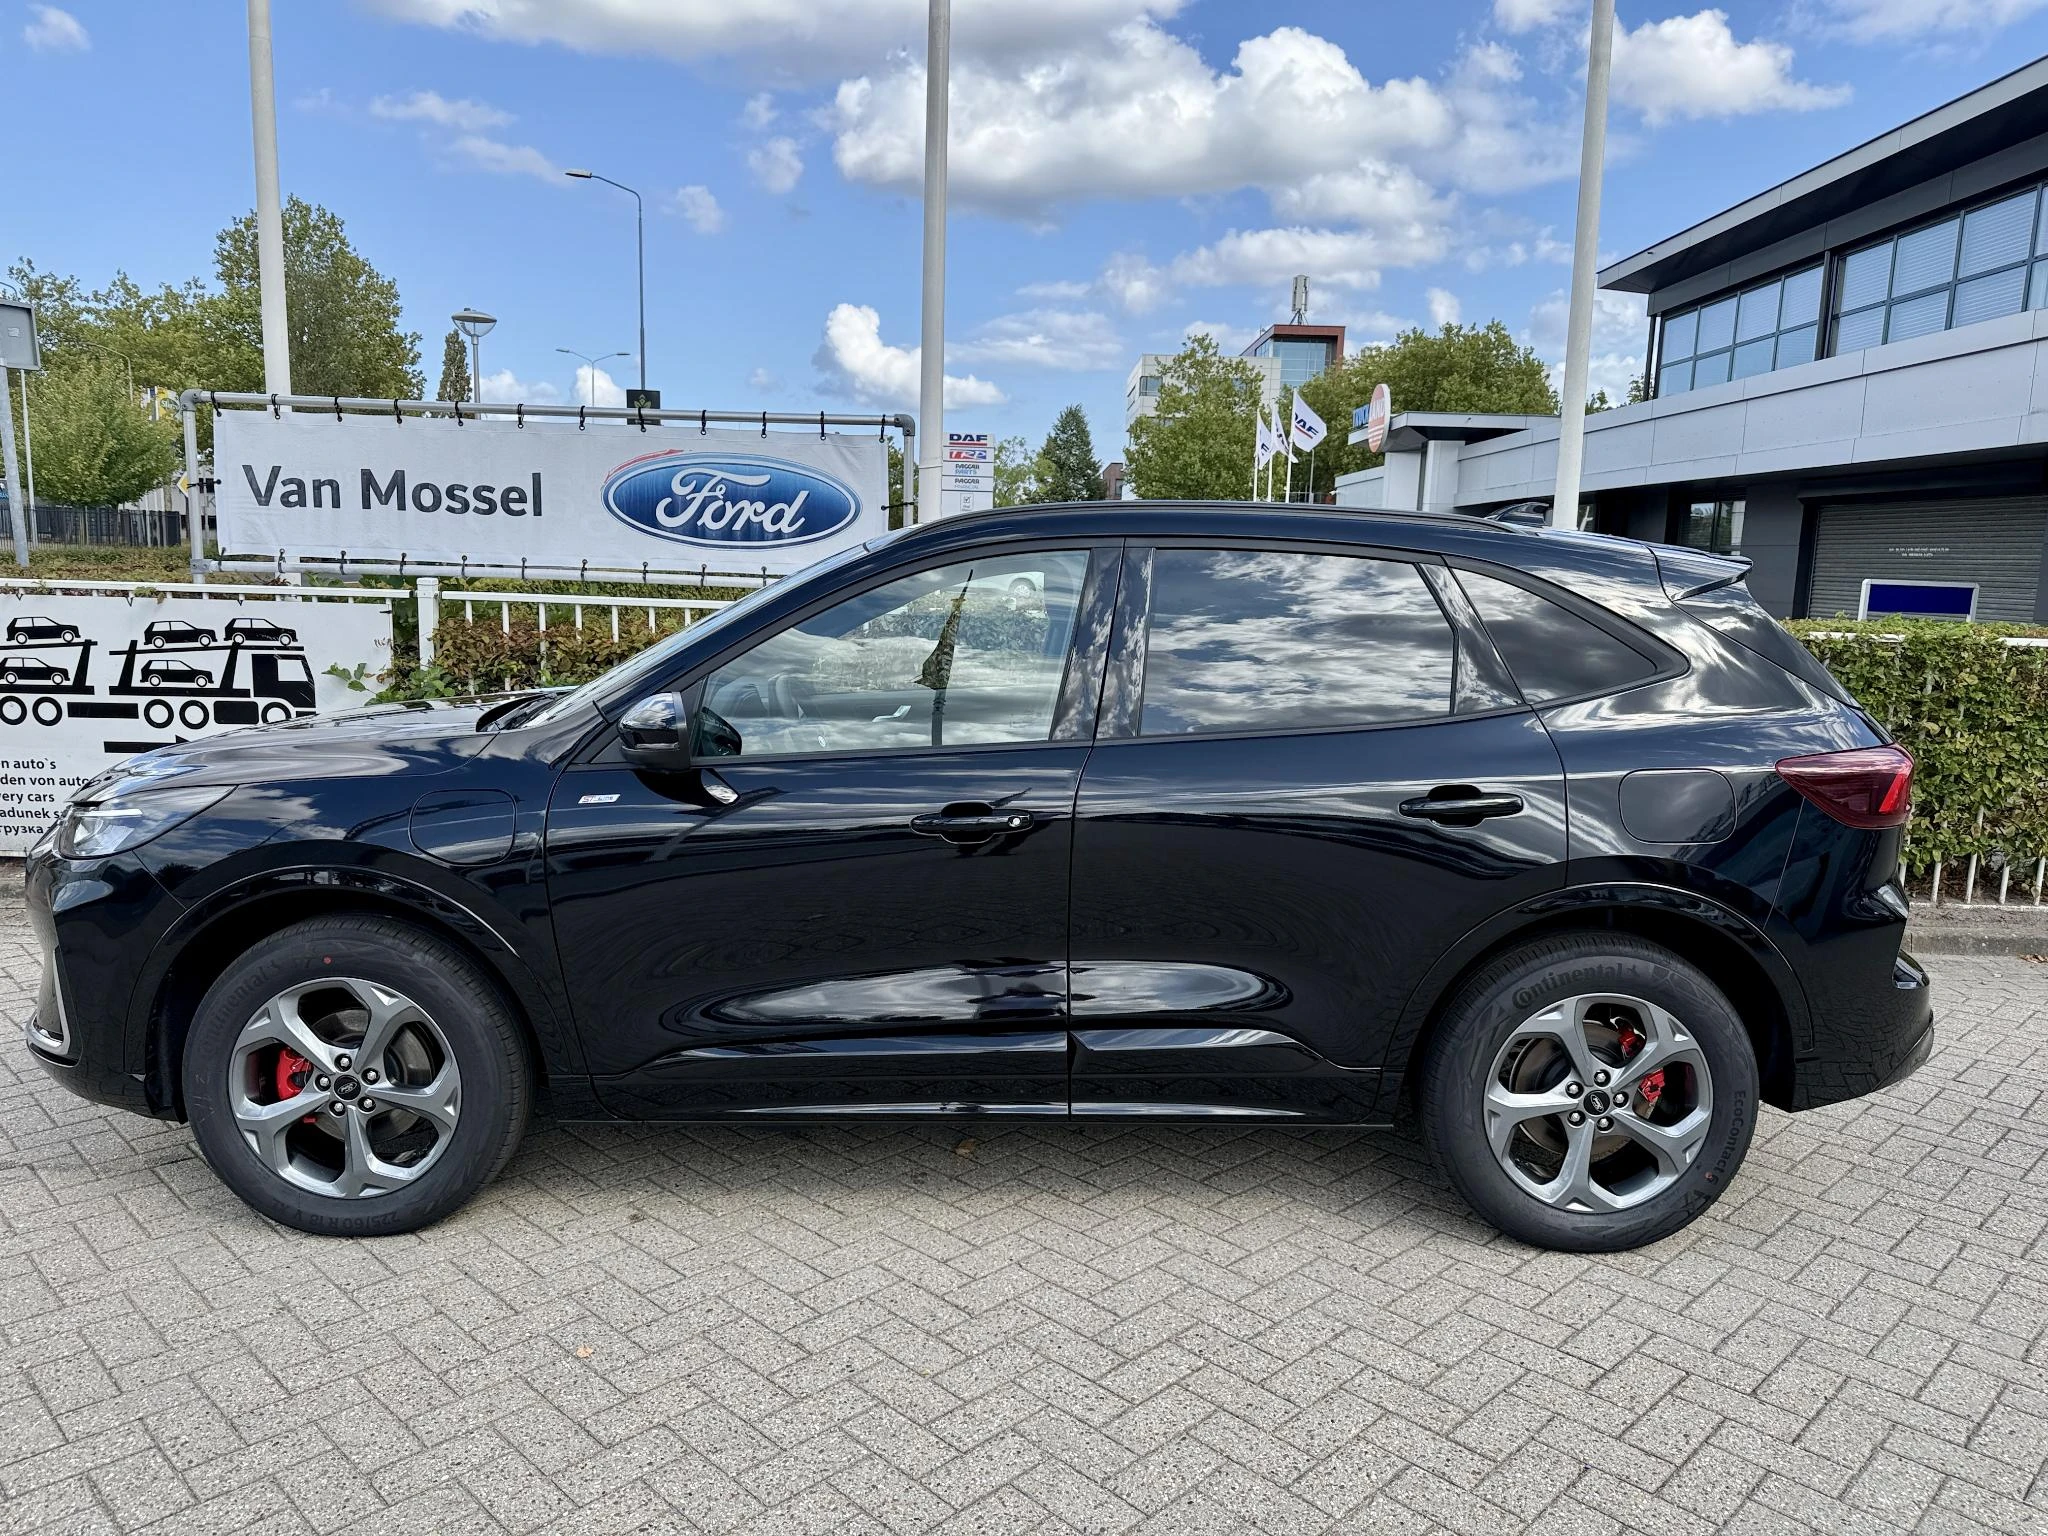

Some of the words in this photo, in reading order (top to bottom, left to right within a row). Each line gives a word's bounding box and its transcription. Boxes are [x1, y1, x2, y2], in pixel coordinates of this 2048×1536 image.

[949, 433, 988, 442] DAF
[242, 464, 341, 508] Van
[360, 468, 543, 517] Mossel
[655, 467, 810, 534] Ford
[0, 793, 24, 804] ery
[27, 793, 55, 802] cars
[29, 777, 55, 786] von
[1511, 962, 1624, 1010] Continental
[1713, 1090, 1747, 1174] EcoContact
